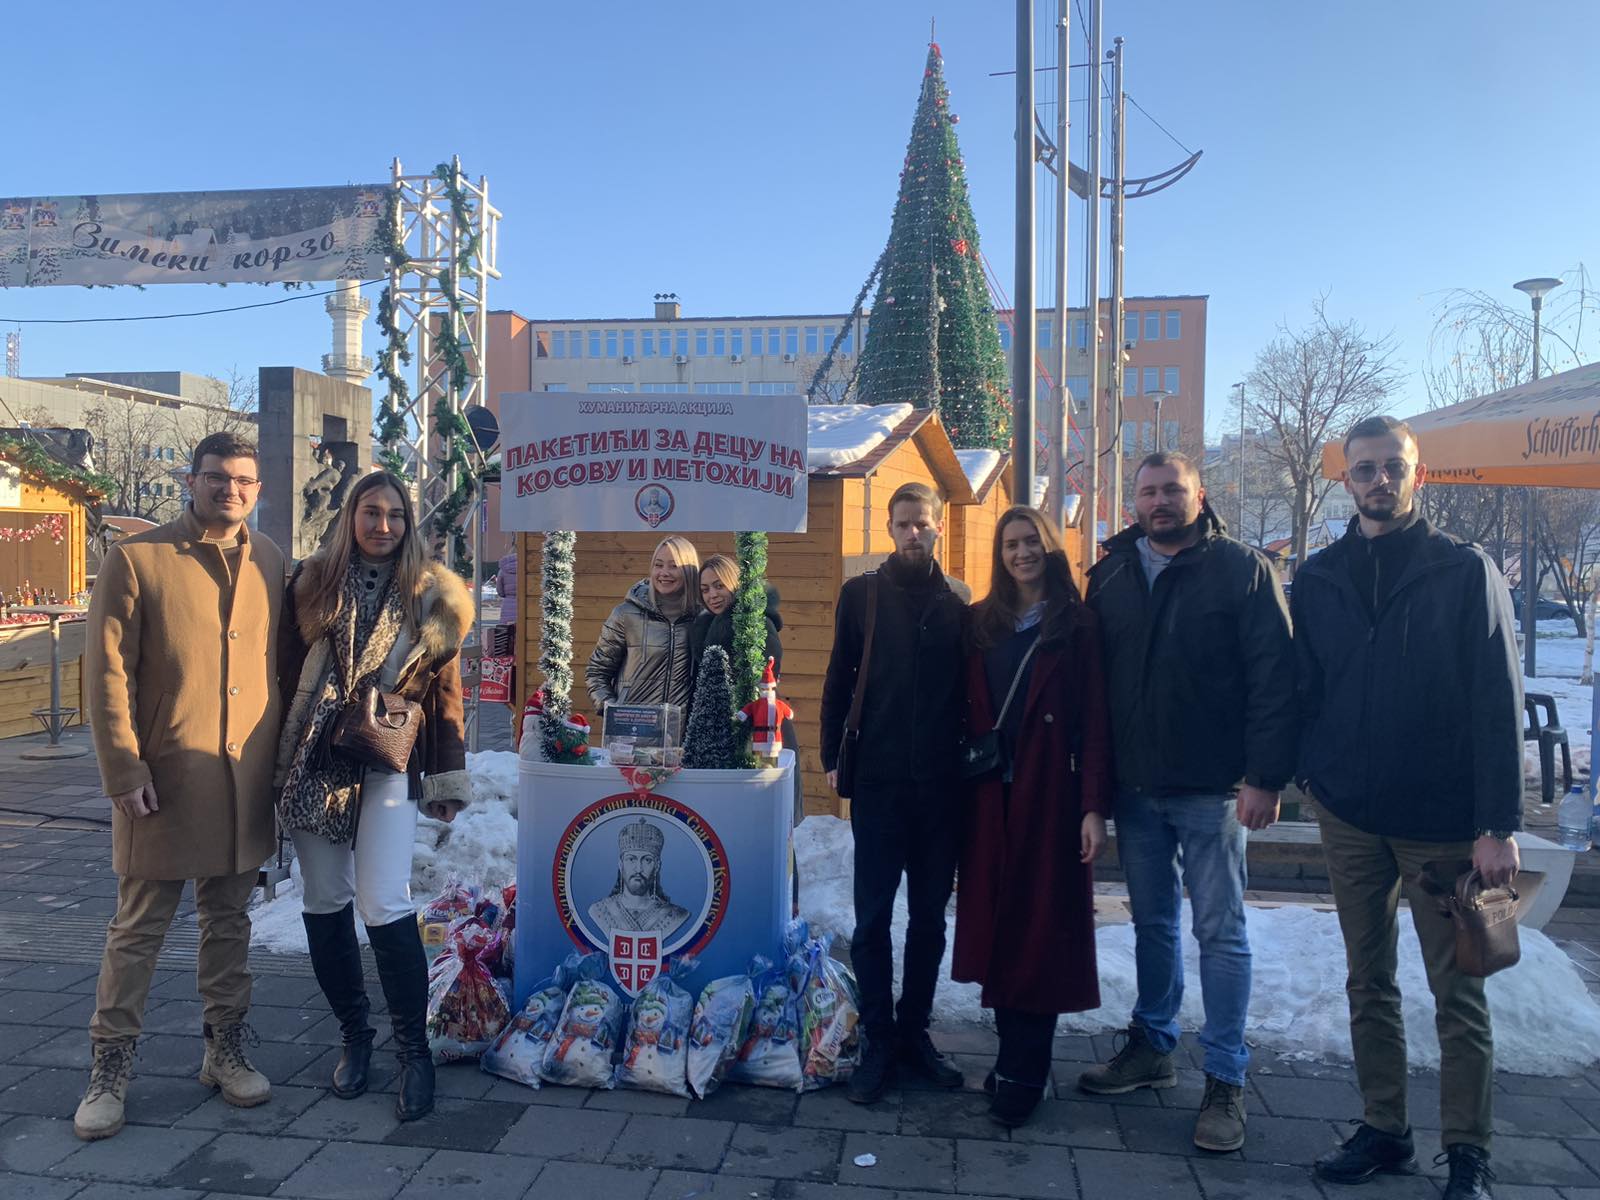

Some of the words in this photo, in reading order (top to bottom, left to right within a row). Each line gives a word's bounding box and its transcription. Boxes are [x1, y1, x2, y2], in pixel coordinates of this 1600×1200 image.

[72, 221, 210, 272] Зимски
[232, 230, 338, 271] корзо
[578, 400, 678, 415] ХУМАНИТАРНА
[679, 401, 734, 416] АКЦИЈА
[505, 428, 648, 471] ПАКЕТИЋИ
[655, 428, 689, 451] ЗА
[692, 430, 765, 462] ДЕЦУ
[769, 443, 806, 473] НА
[1521, 410, 1600, 460] Schöfferh
[516, 459, 624, 498] КОСОВУ
[627, 458, 651, 481] И
[653, 458, 795, 499] МЕТОХИЈИ
